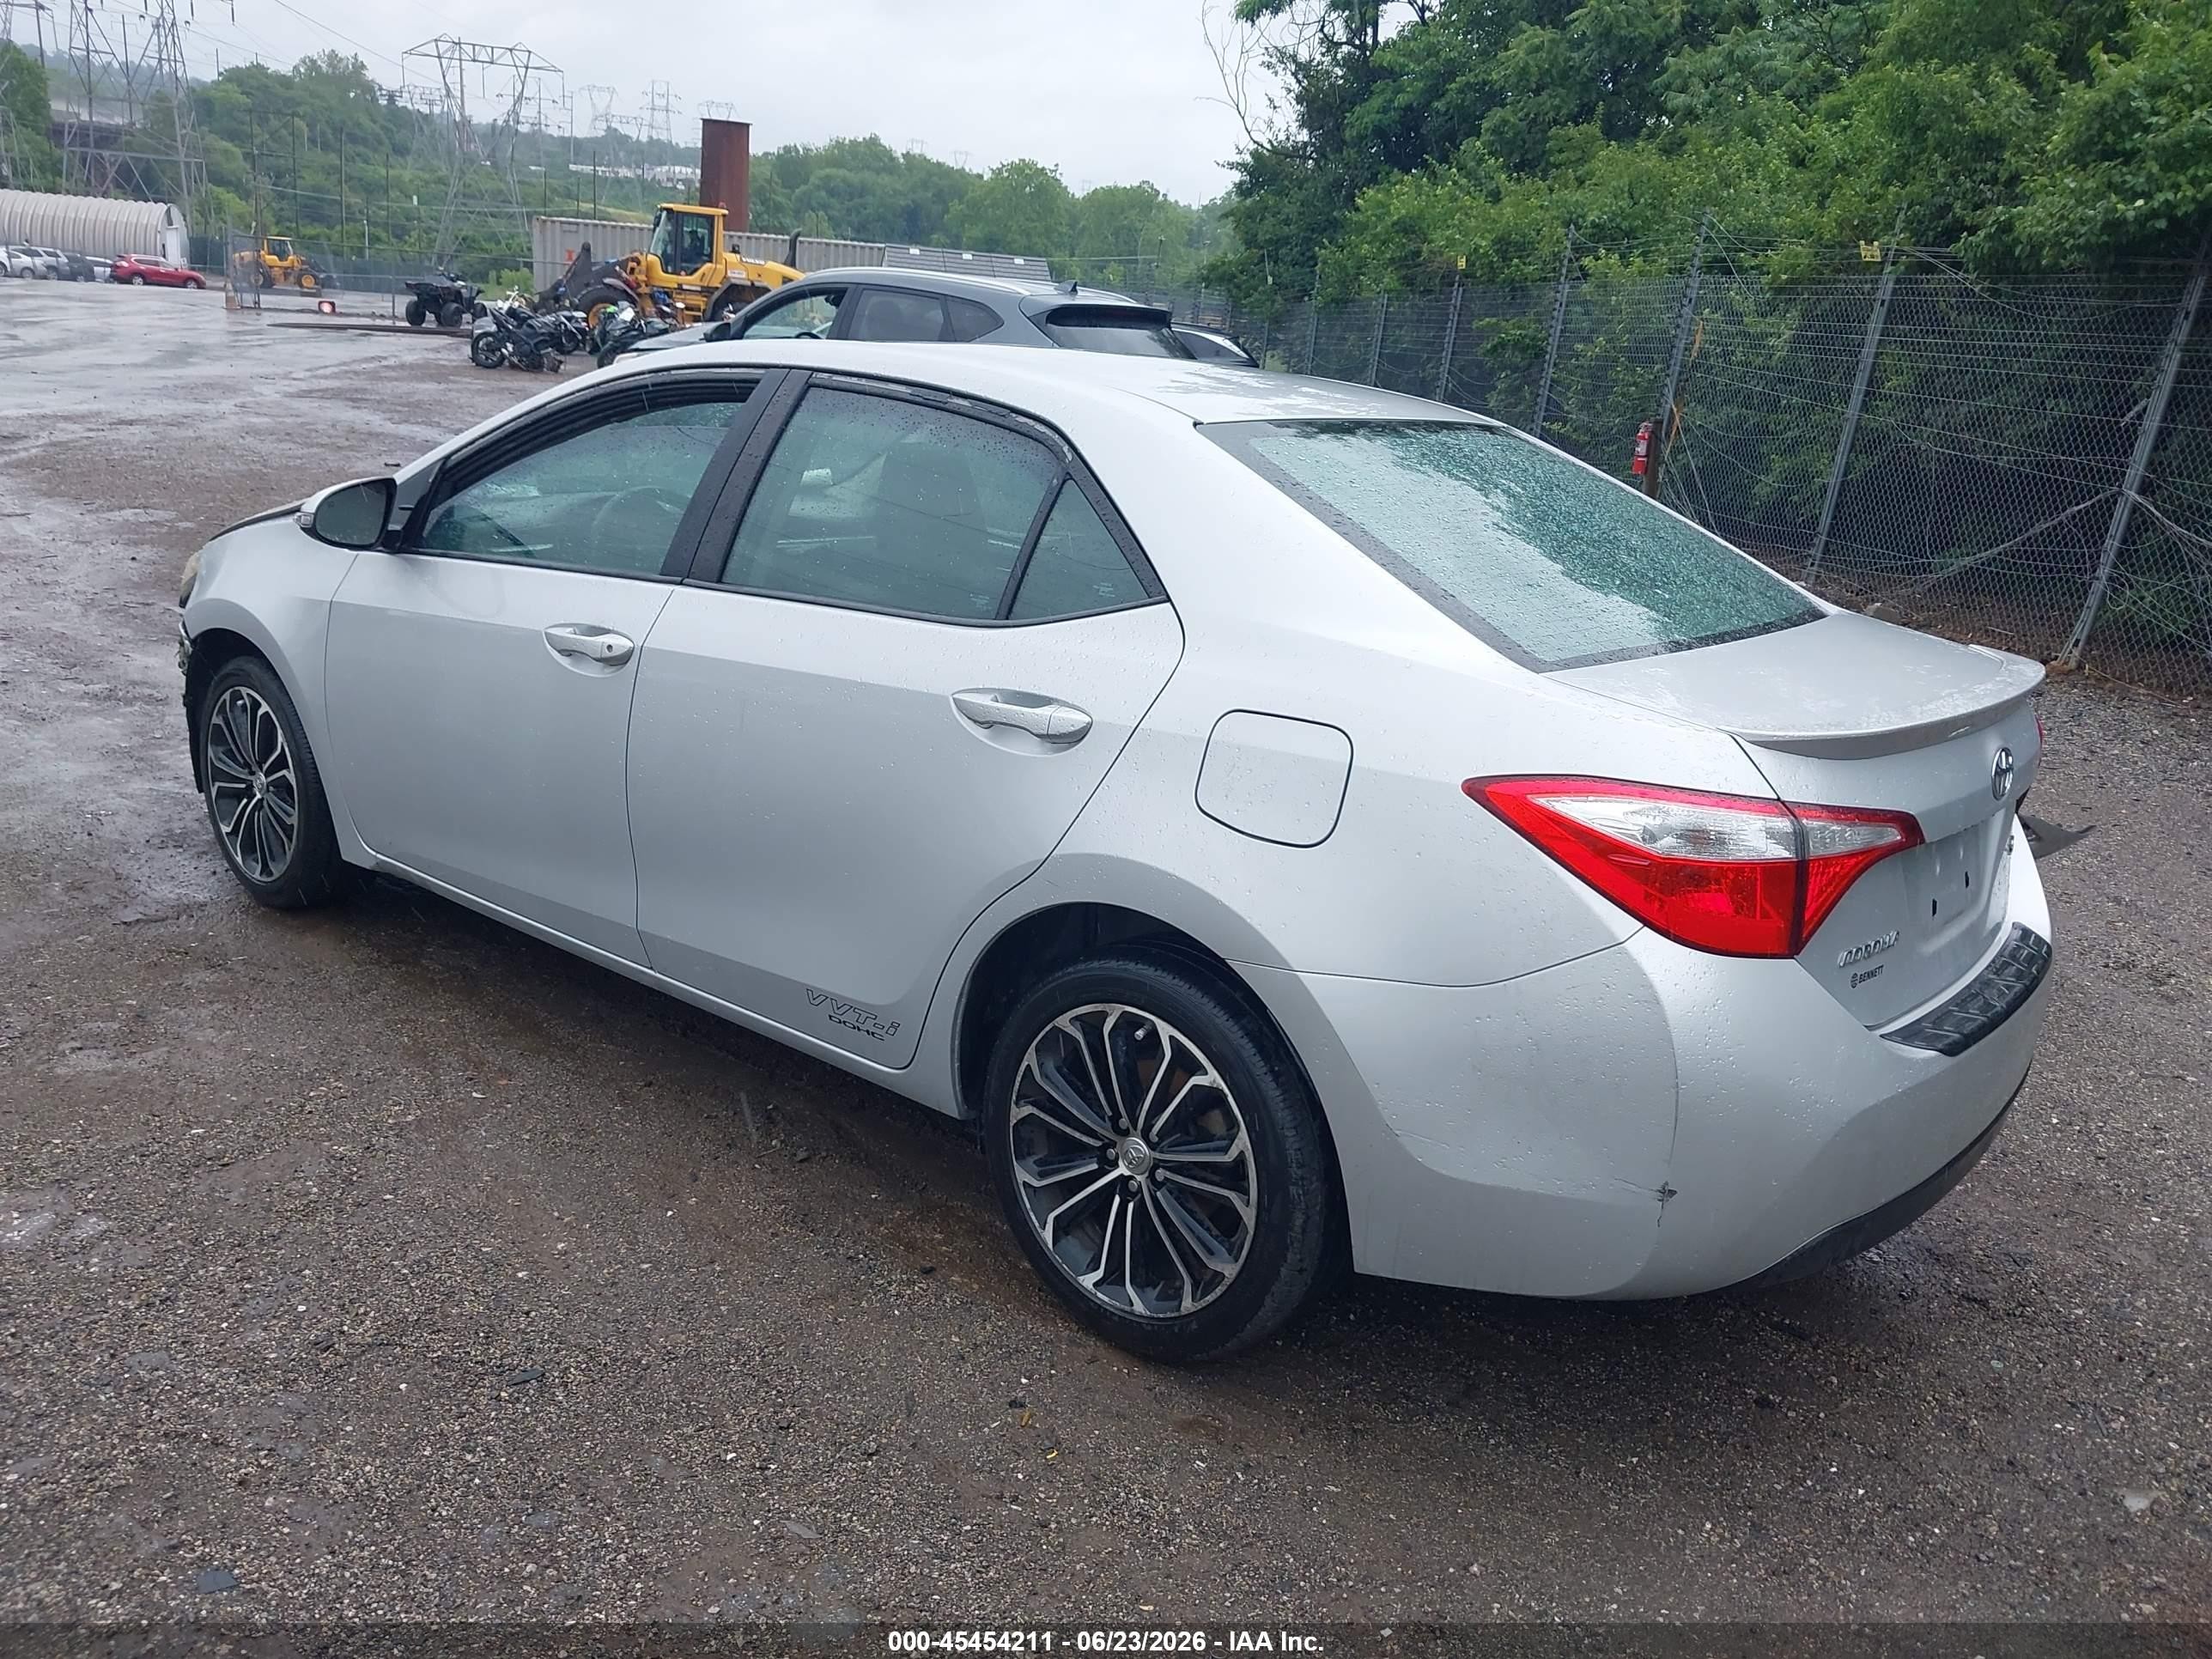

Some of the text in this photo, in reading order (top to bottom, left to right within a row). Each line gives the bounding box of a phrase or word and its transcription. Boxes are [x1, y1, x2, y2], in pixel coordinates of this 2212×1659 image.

[1858, 964, 1885, 984] BENNETT
[805, 988, 901, 1037] VVT-i
[828, 1014, 885, 1042] DOHC
